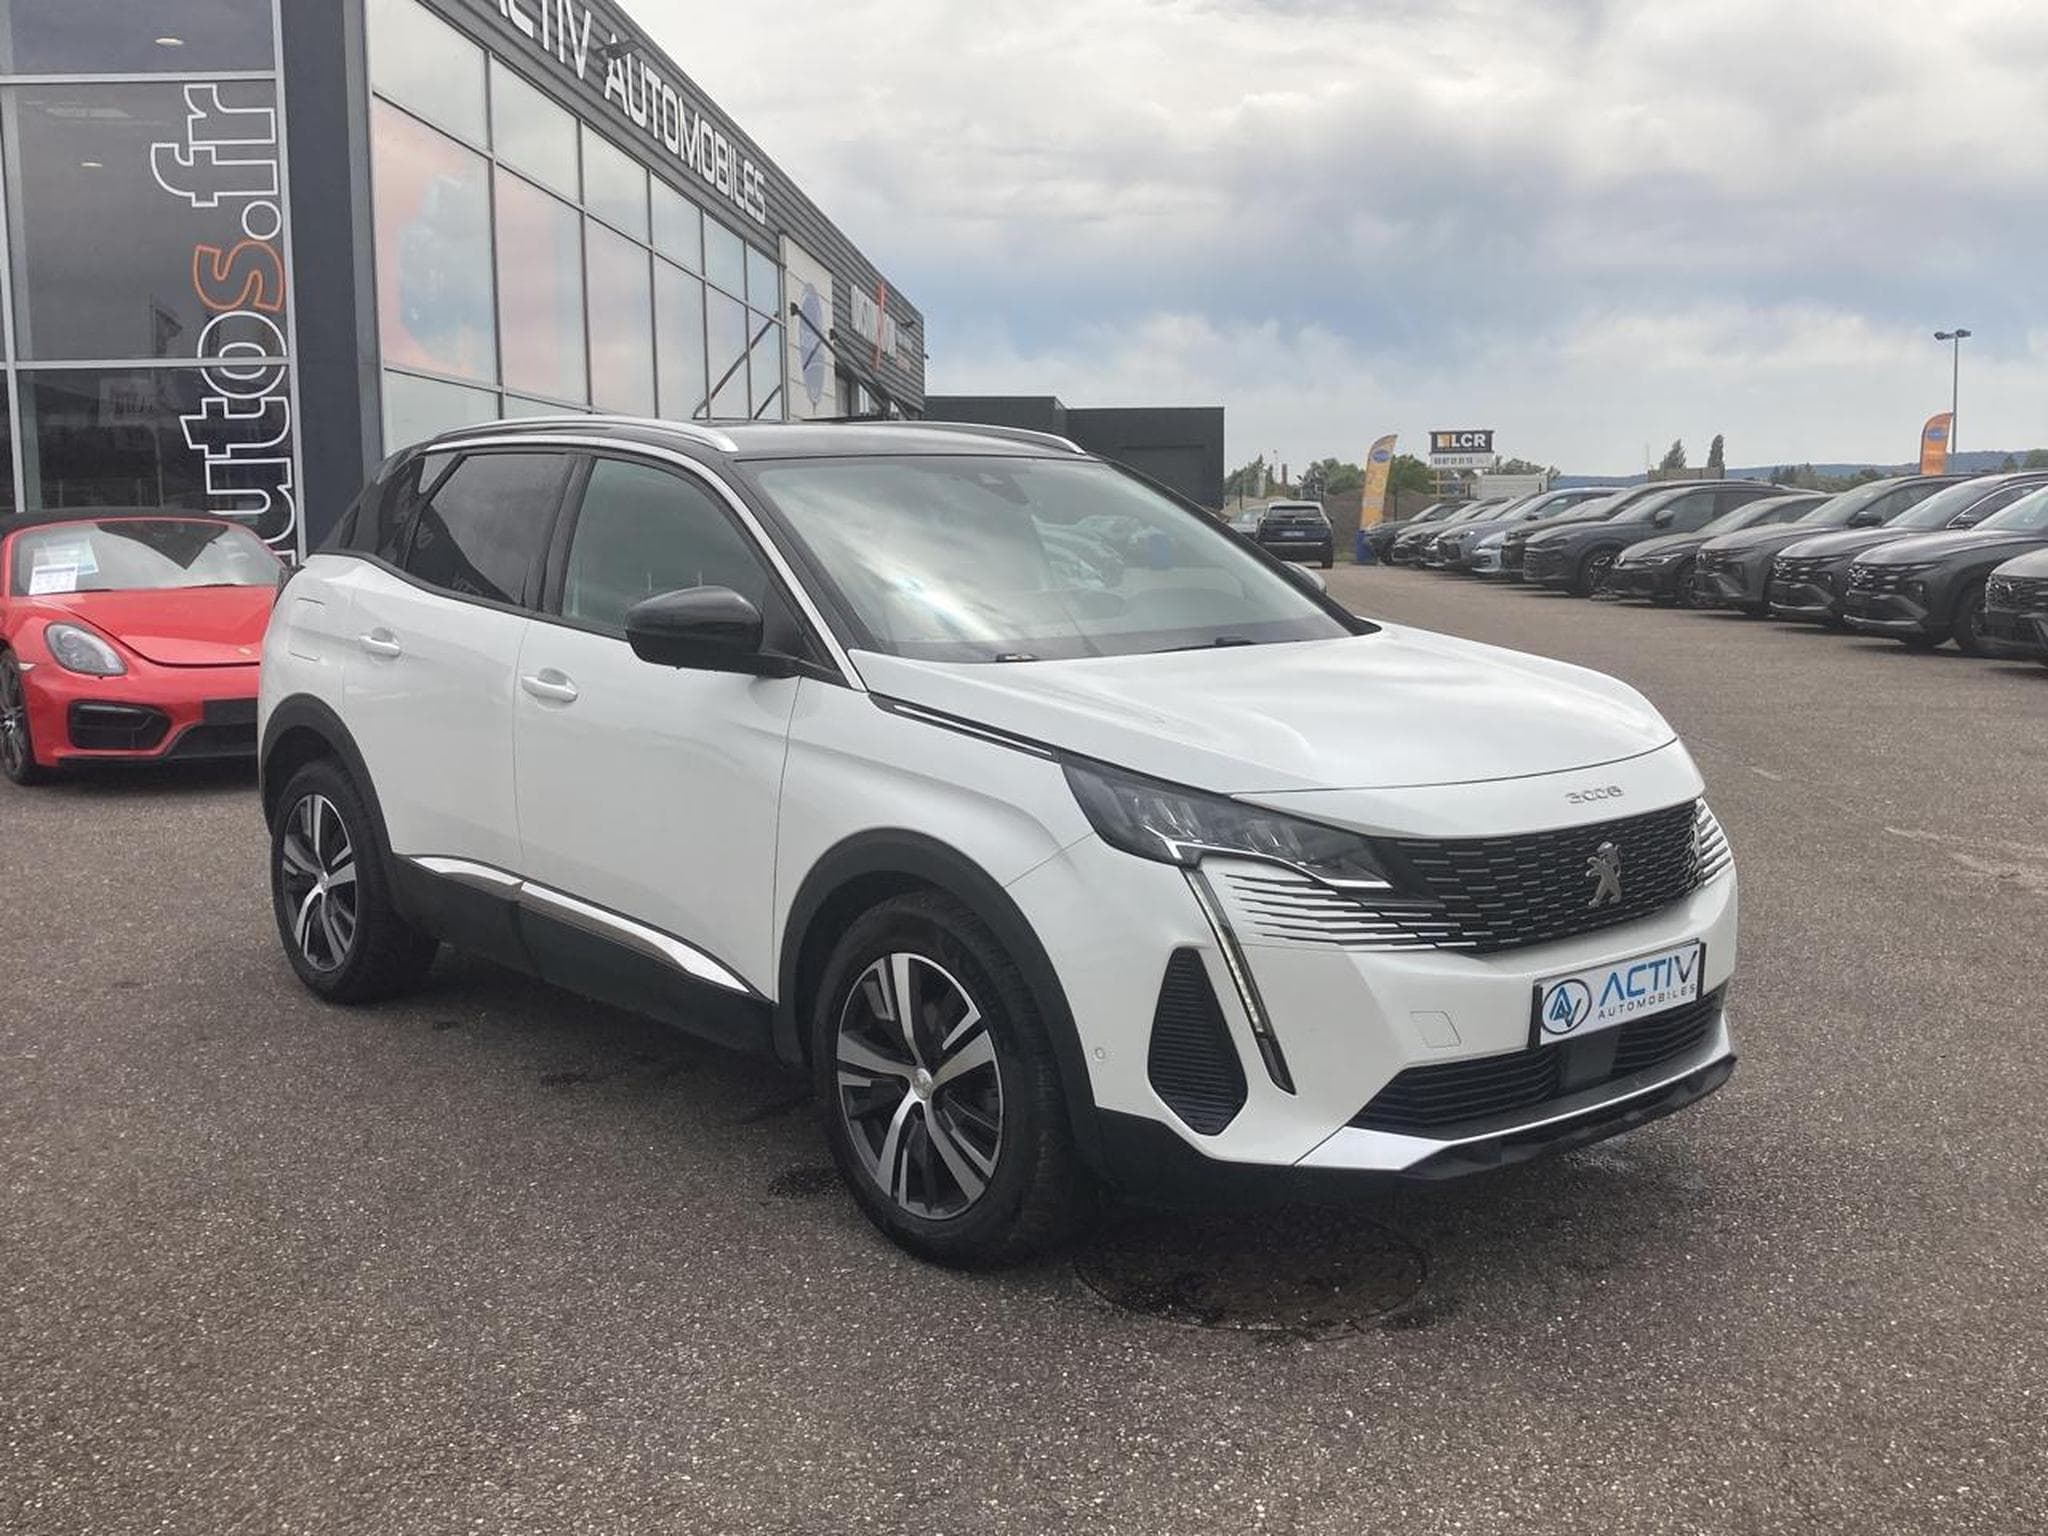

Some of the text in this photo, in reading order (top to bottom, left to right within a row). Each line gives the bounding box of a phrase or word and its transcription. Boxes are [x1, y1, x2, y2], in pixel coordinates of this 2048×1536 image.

[604, 32, 767, 225] AUTOMOBILES
[150, 84, 297, 566] utos.fr
[1451, 433, 1486, 448] LCR
[1599, 983, 1697, 1021] AUTOMOBILES
[1600, 950, 1698, 1007] ACTIV
